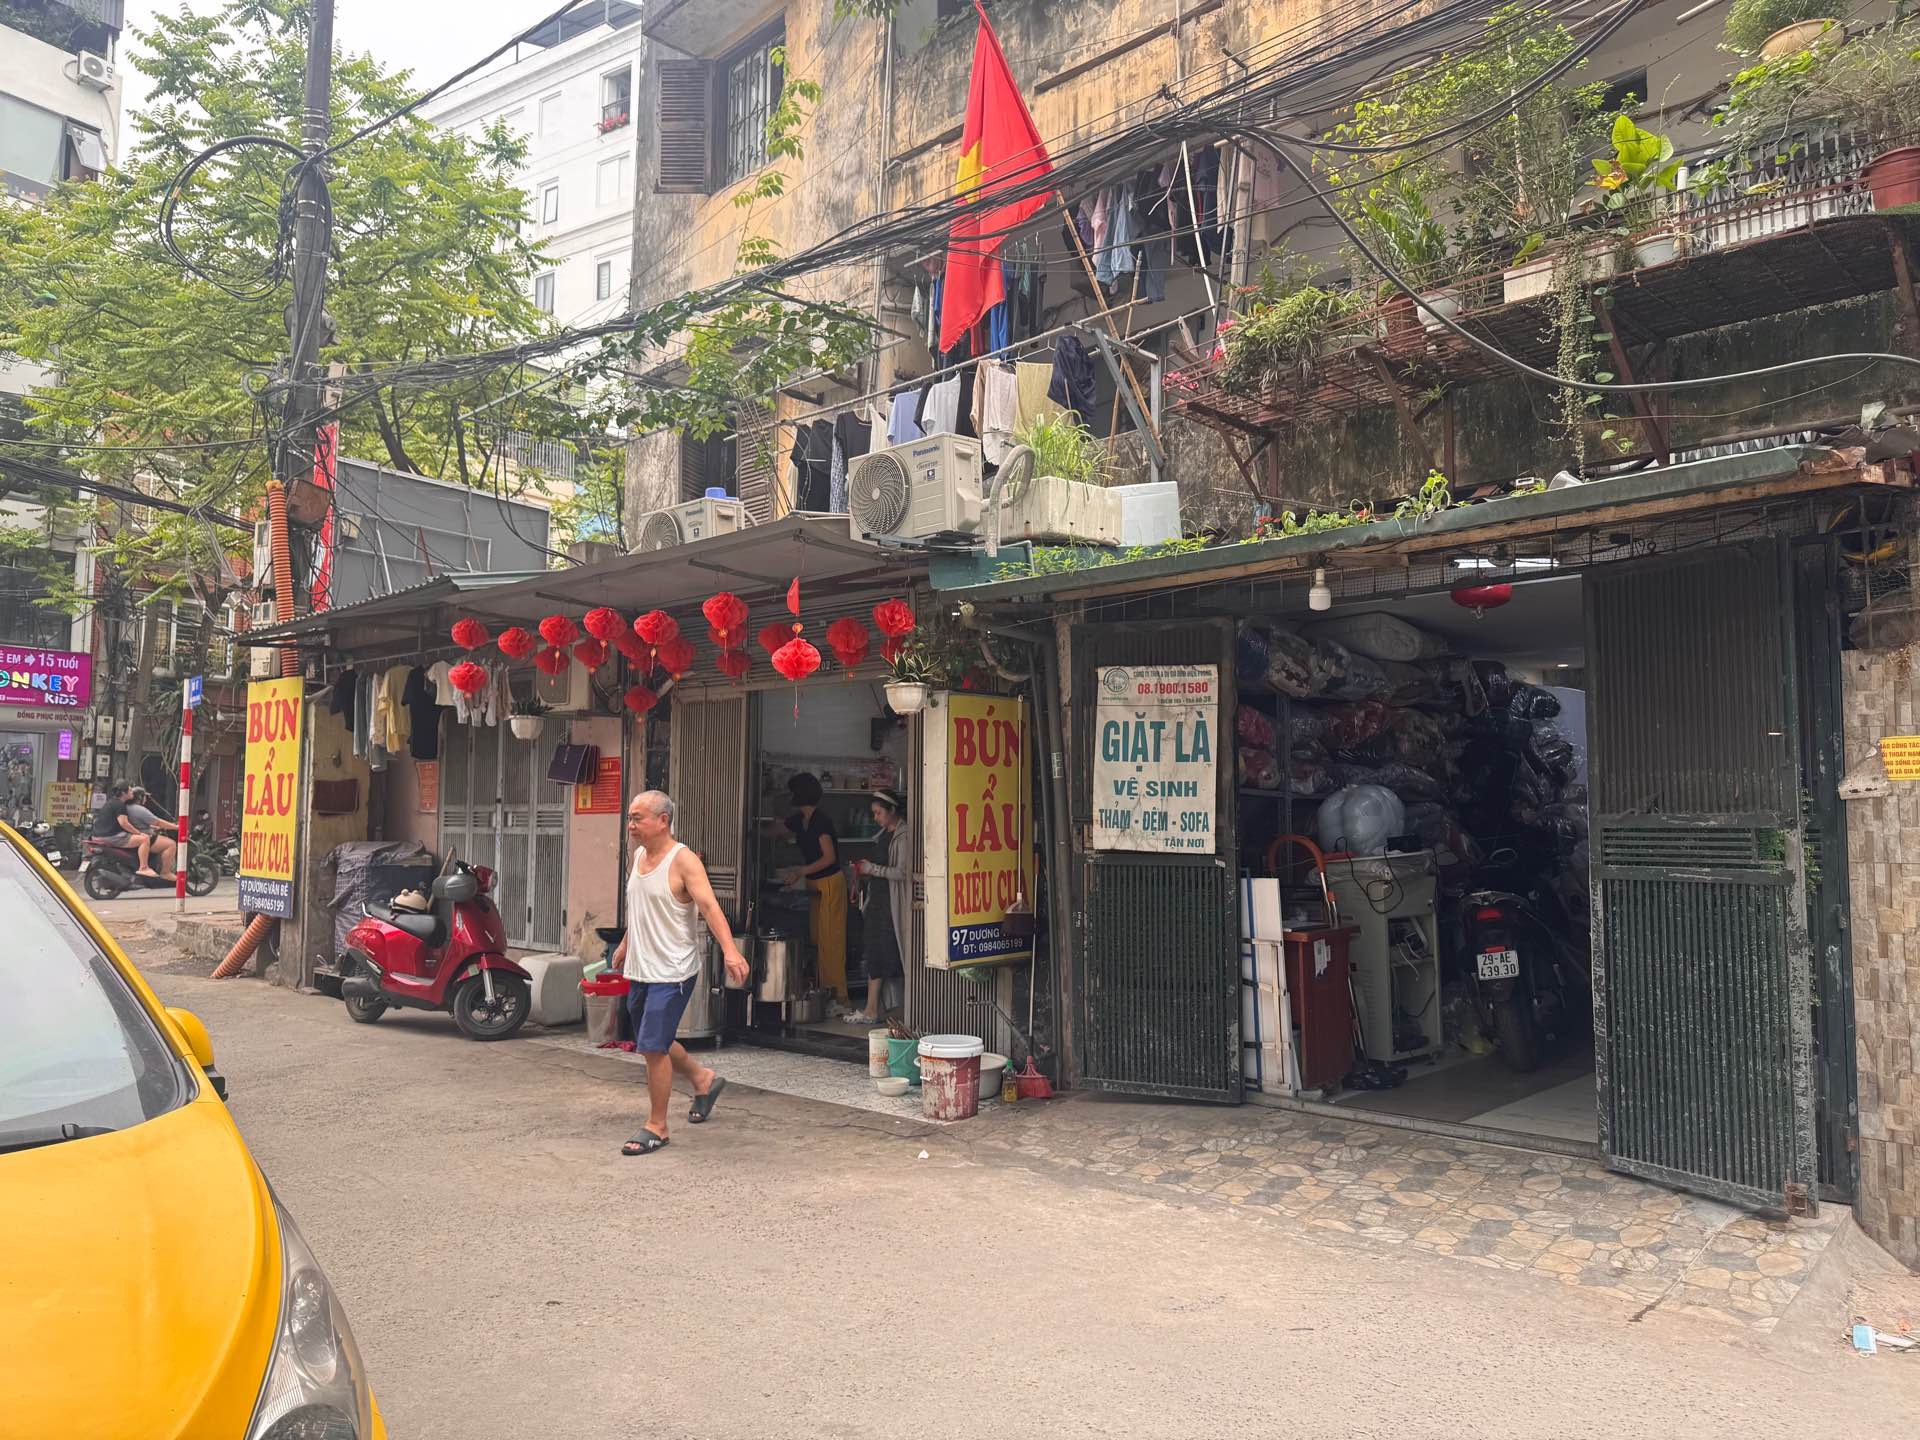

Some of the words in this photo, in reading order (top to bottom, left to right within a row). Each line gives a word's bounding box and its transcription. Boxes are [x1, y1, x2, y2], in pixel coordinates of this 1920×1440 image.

[38, 653, 55, 667] 15
[248, 687, 299, 743] BÚN
[953, 705, 1026, 768] BÚN
[1102, 711, 1166, 772] GIẶT
[1175, 710, 1211, 763] LÀ
[245, 747, 295, 816] LẨU
[1113, 777, 1139, 800] VỆ
[1145, 780, 1198, 798] SINH
[955, 773, 1026, 852] LẨU
[1098, 800, 1131, 829] THẢM
[1142, 806, 1168, 836] ĐỆM
[1180, 811, 1210, 833] SOFA
[241, 819, 268, 871] RIÊU
[267, 833, 290, 874] CUA
[1164, 836, 1184, 849] TẬN
[240, 880, 248, 891] 97
[953, 858, 993, 915] RIÊU
[952, 928, 968, 946] 97
[969, 927, 1000, 941] DƯƠNG
[963, 943, 977, 954] ĐT:
[978, 938, 1023, 953] 0984065199
[1481, 963, 1516, 977] 439.30
[1482, 952, 1511, 965] 29-AE
